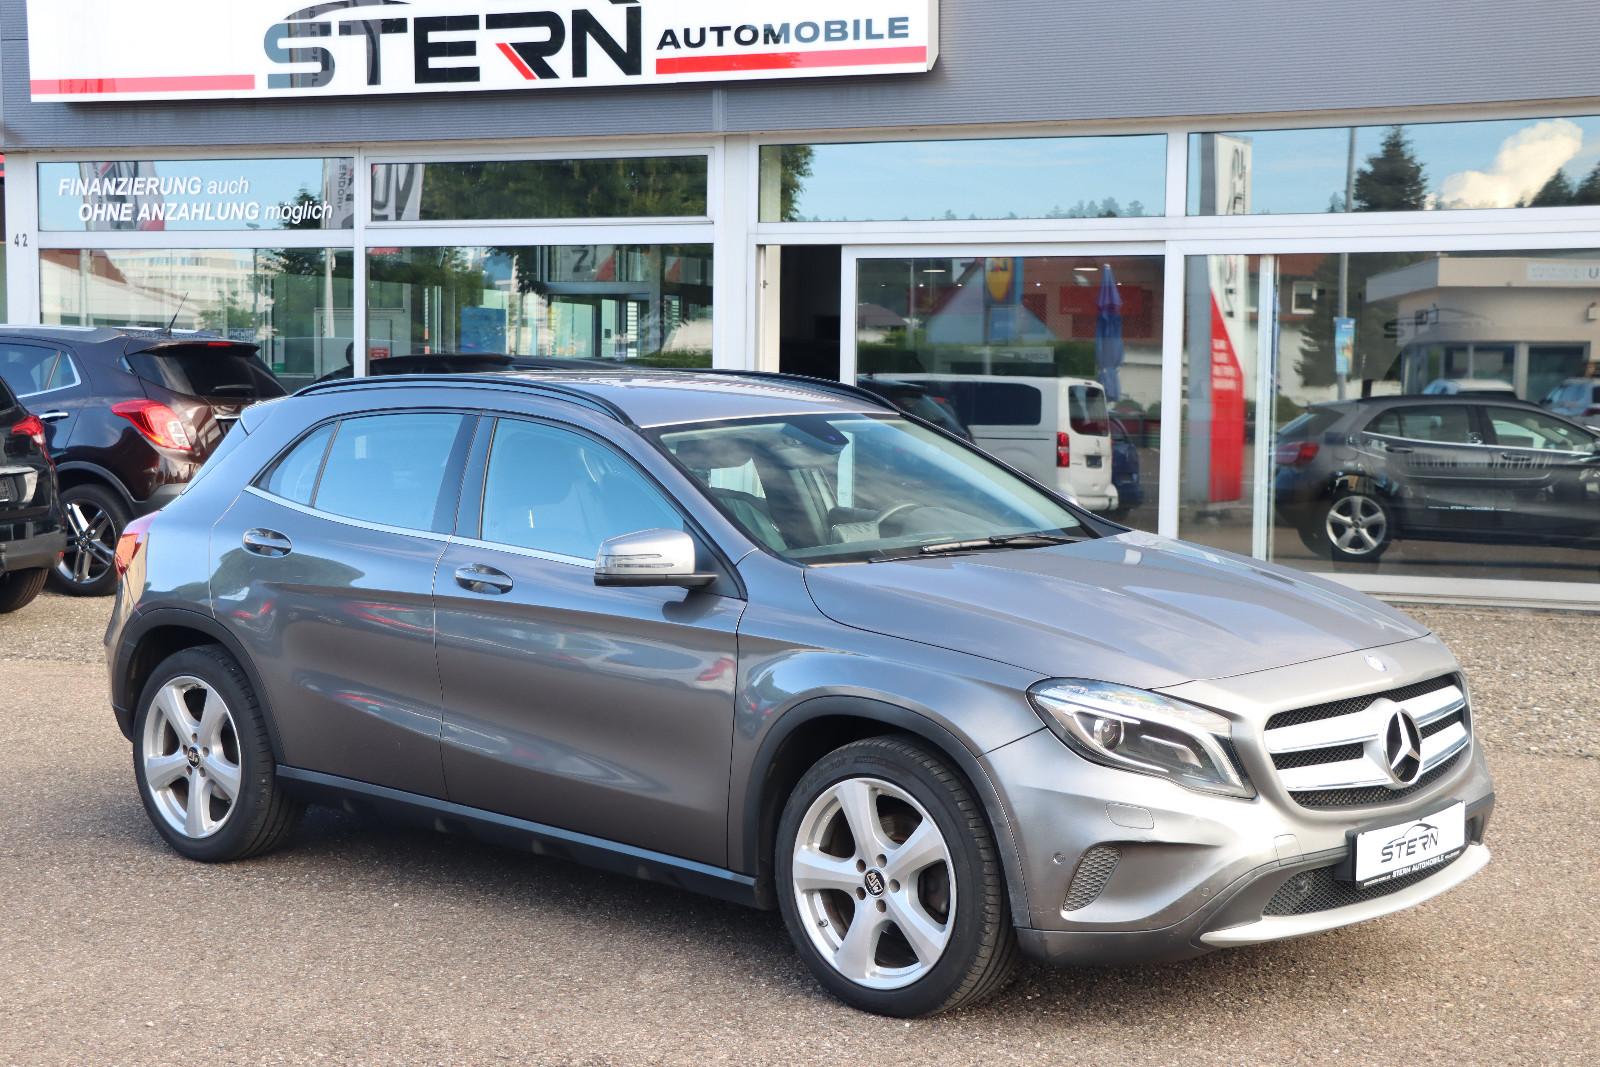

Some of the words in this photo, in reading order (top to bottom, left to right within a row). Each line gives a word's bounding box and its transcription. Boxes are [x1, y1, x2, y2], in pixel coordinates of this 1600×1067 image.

[656, 16, 909, 51] AUTOMOBILE
[263, 6, 642, 90] STERN
[58, 176, 202, 197] FINANZIERUNG
[207, 176, 249, 195] auch
[78, 203, 133, 222] OHNE
[137, 202, 260, 221] ANZAHLUNG
[264, 200, 333, 224] möglich
[14, 233, 28, 247] 42
[1381, 832, 1439, 864] STERN
[1392, 866, 1411, 878] STERN
[1411, 855, 1445, 872] AUTOMOBILE
